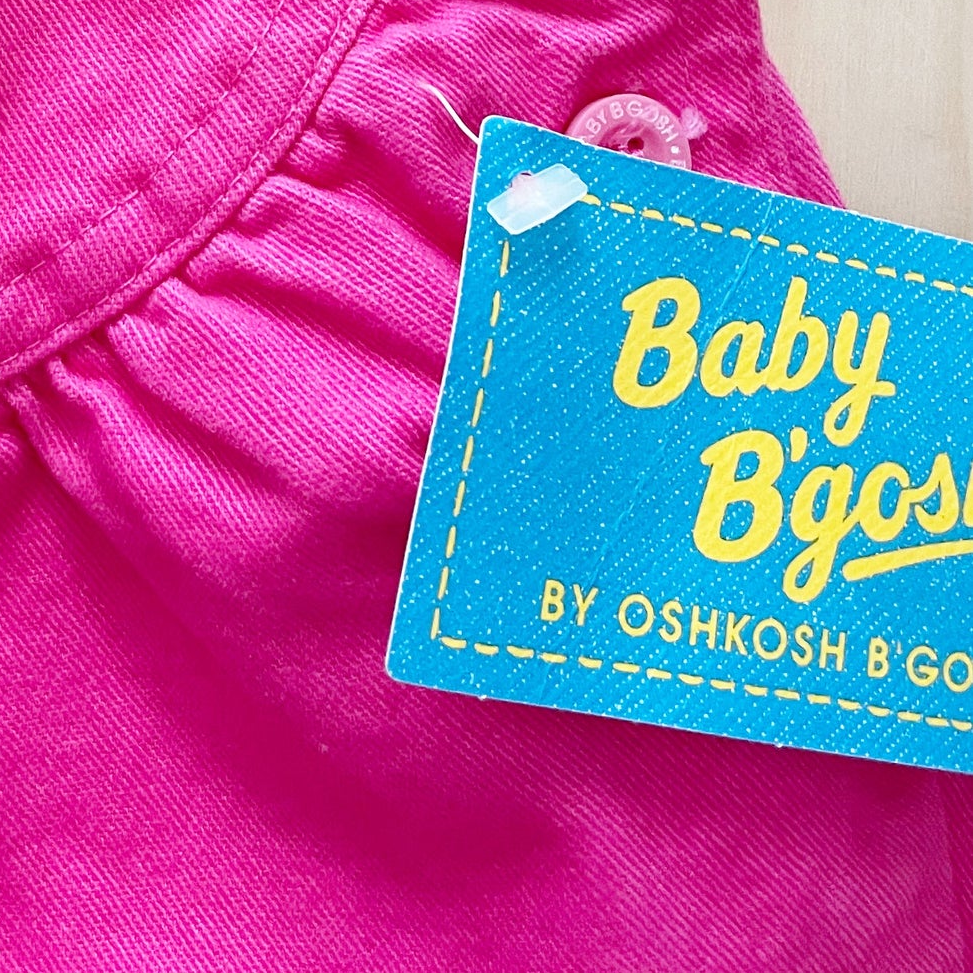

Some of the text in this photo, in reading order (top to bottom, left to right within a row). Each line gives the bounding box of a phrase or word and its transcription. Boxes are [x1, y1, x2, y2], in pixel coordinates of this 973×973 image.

[612, 276, 895, 447] Baby
[693, 427, 973, 603] B'gos
[539, 580, 600, 627] BY
[618, 593, 848, 672] OSHKOSH
